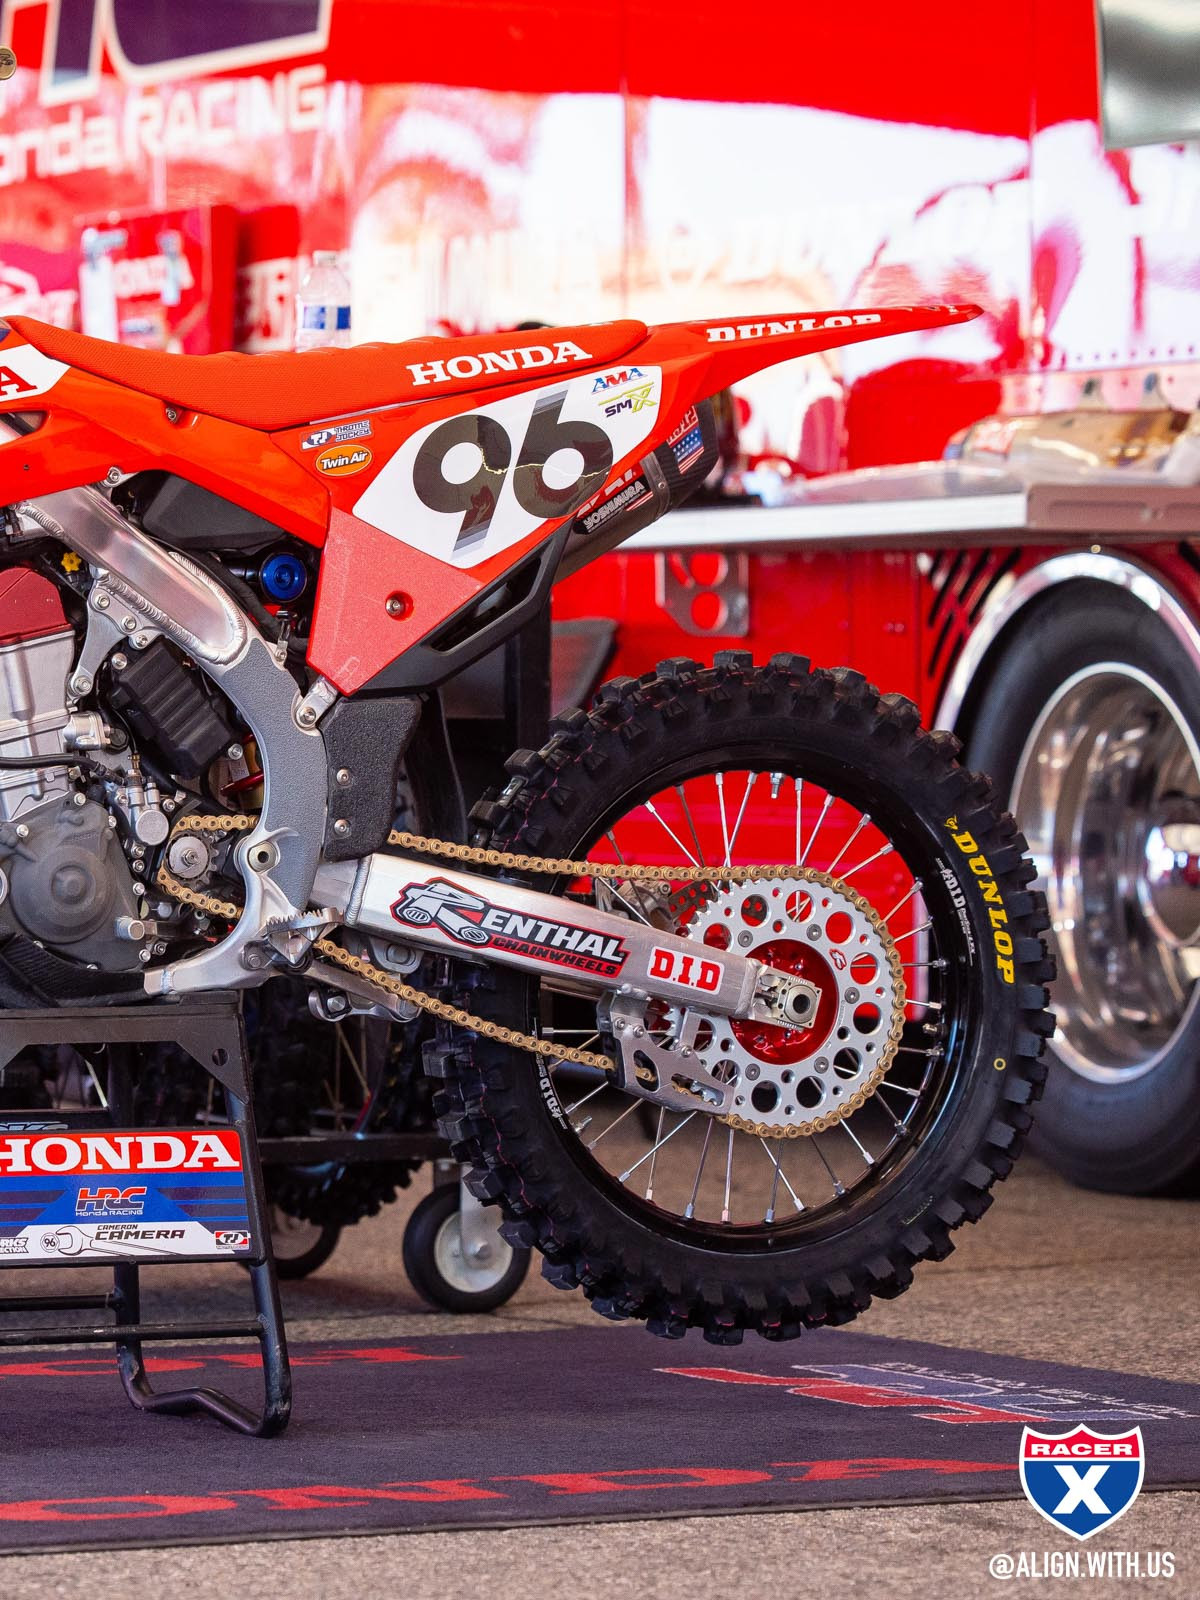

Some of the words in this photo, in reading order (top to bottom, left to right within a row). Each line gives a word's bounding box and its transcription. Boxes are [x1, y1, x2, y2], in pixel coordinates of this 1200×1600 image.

[126, 65, 326, 158] RACING
[706, 313, 881, 342] DUNLOP
[406, 340, 593, 385] HONDA
[592, 368, 648, 394] AMA
[604, 387, 658, 418] SMX
[335, 420, 369, 434] THROTTLE
[336, 429, 371, 442] JOCKEY
[321, 455, 349, 469] Twin
[350, 451, 368, 464] Air
[411, 384, 614, 557] 96
[583, 480, 646, 529] YOSHIMURA
[397, 882, 625, 963] RENTHAL
[952, 831, 1015, 984] DUNLOP
[492, 936, 617, 976] CHAINWHEELS
[650, 948, 722, 991] D.I.D
[75, 1187, 147, 1212] HRC
[44, 1238, 56, 1248] 96
[94, 1229, 186, 1241] CAMERA
[97, 1223, 139, 1231] CAMERON
